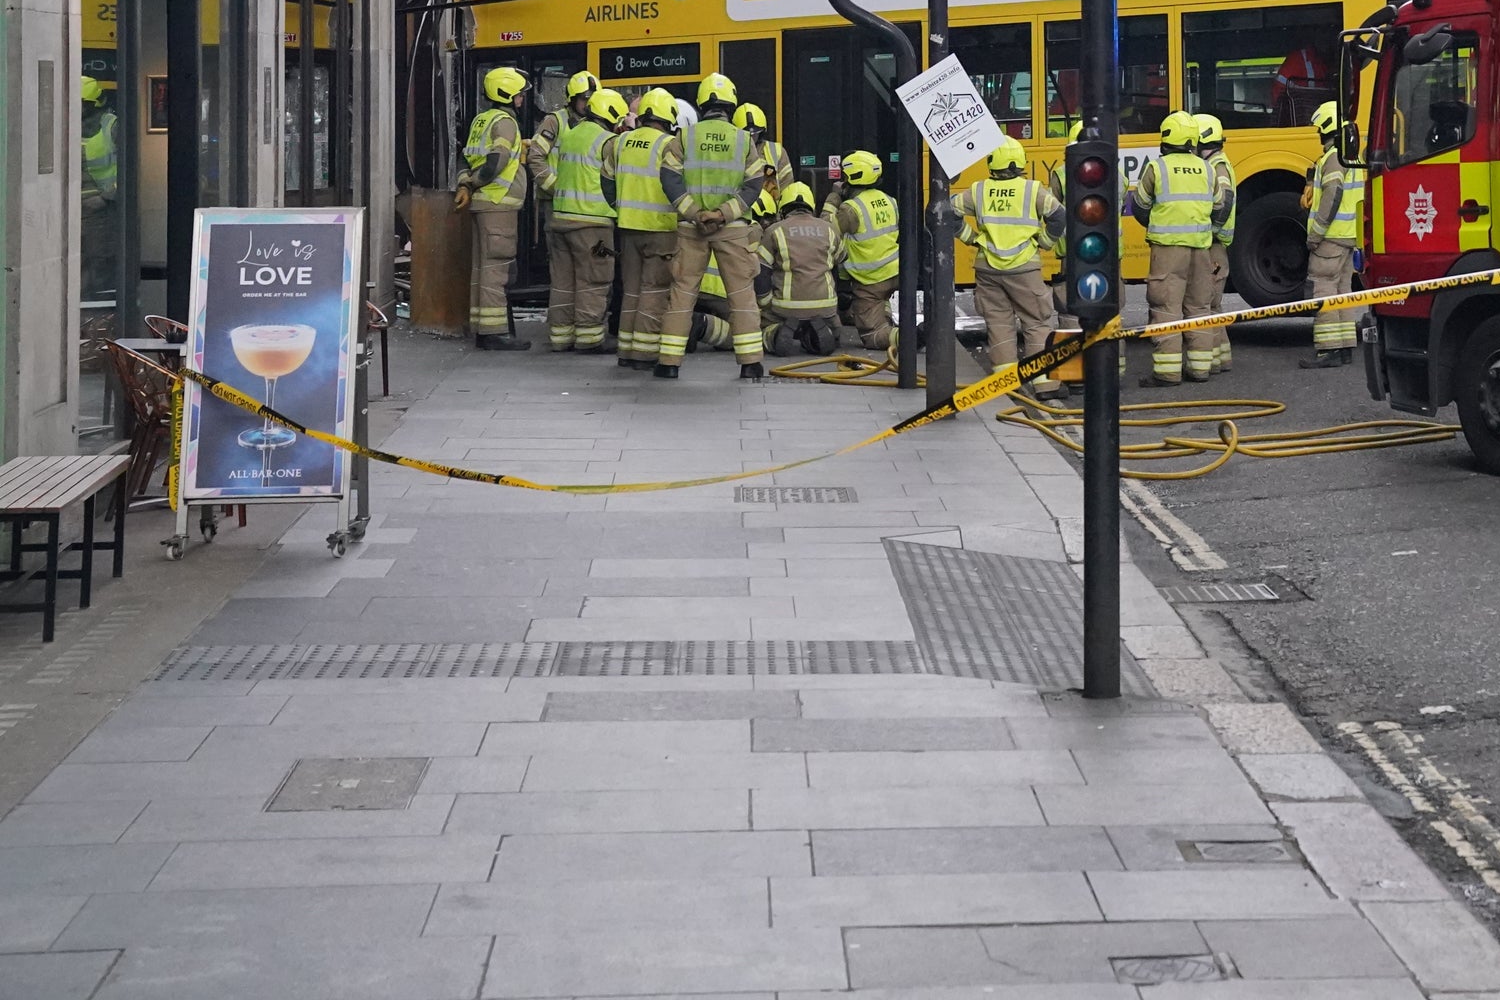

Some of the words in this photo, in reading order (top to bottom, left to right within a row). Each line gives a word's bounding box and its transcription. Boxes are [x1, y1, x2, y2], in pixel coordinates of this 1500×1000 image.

[584, 1, 660, 23] AIRLINES
[615, 55, 625, 72] 8
[629, 57, 650, 69] Bow
[652, 54, 687, 68] Church
[625, 139, 650, 149] FIRE
[705, 133, 726, 142] FRU
[700, 143, 731, 152] CREW
[1173, 166, 1203, 175] FRU
[989, 188, 1016, 198] FIRE
[870, 198, 889, 209] FIRE
[988, 199, 1012, 213] A24
[236, 230, 285, 266] Love
[291, 239, 318, 261] is
[239, 266, 312, 286] LOVE
[1020, 352, 1055, 379] HAZARD
[1056, 340, 1082, 362] ZONE
[956, 395, 971, 410] DO
[970, 387, 990, 404] NOT
[988, 372, 1019, 393] CROSS
